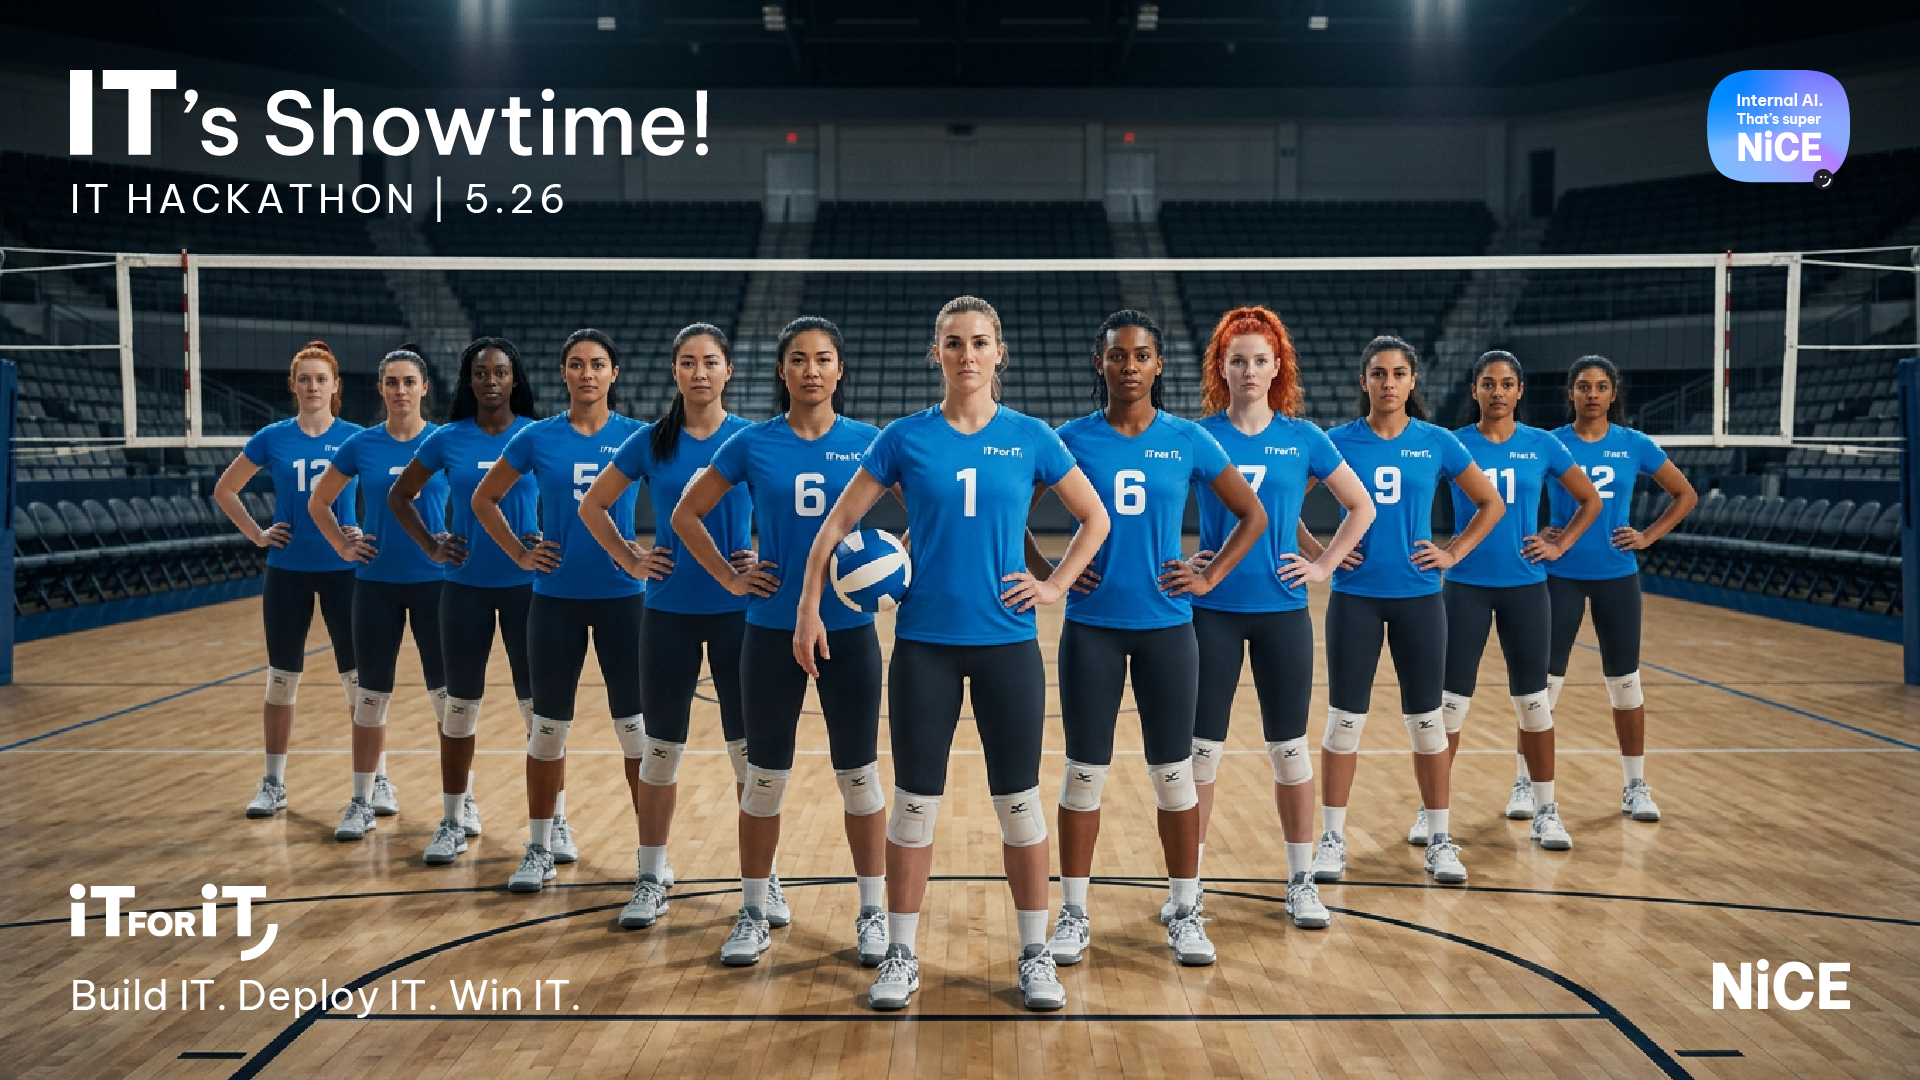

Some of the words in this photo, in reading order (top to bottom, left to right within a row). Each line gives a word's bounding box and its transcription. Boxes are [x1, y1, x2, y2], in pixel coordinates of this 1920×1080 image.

[573, 462, 599, 501] 5
[795, 472, 827, 517] 6
[956, 467, 977, 517] 1
[1114, 469, 1147, 515] 6
[1374, 465, 1402, 505] 9
